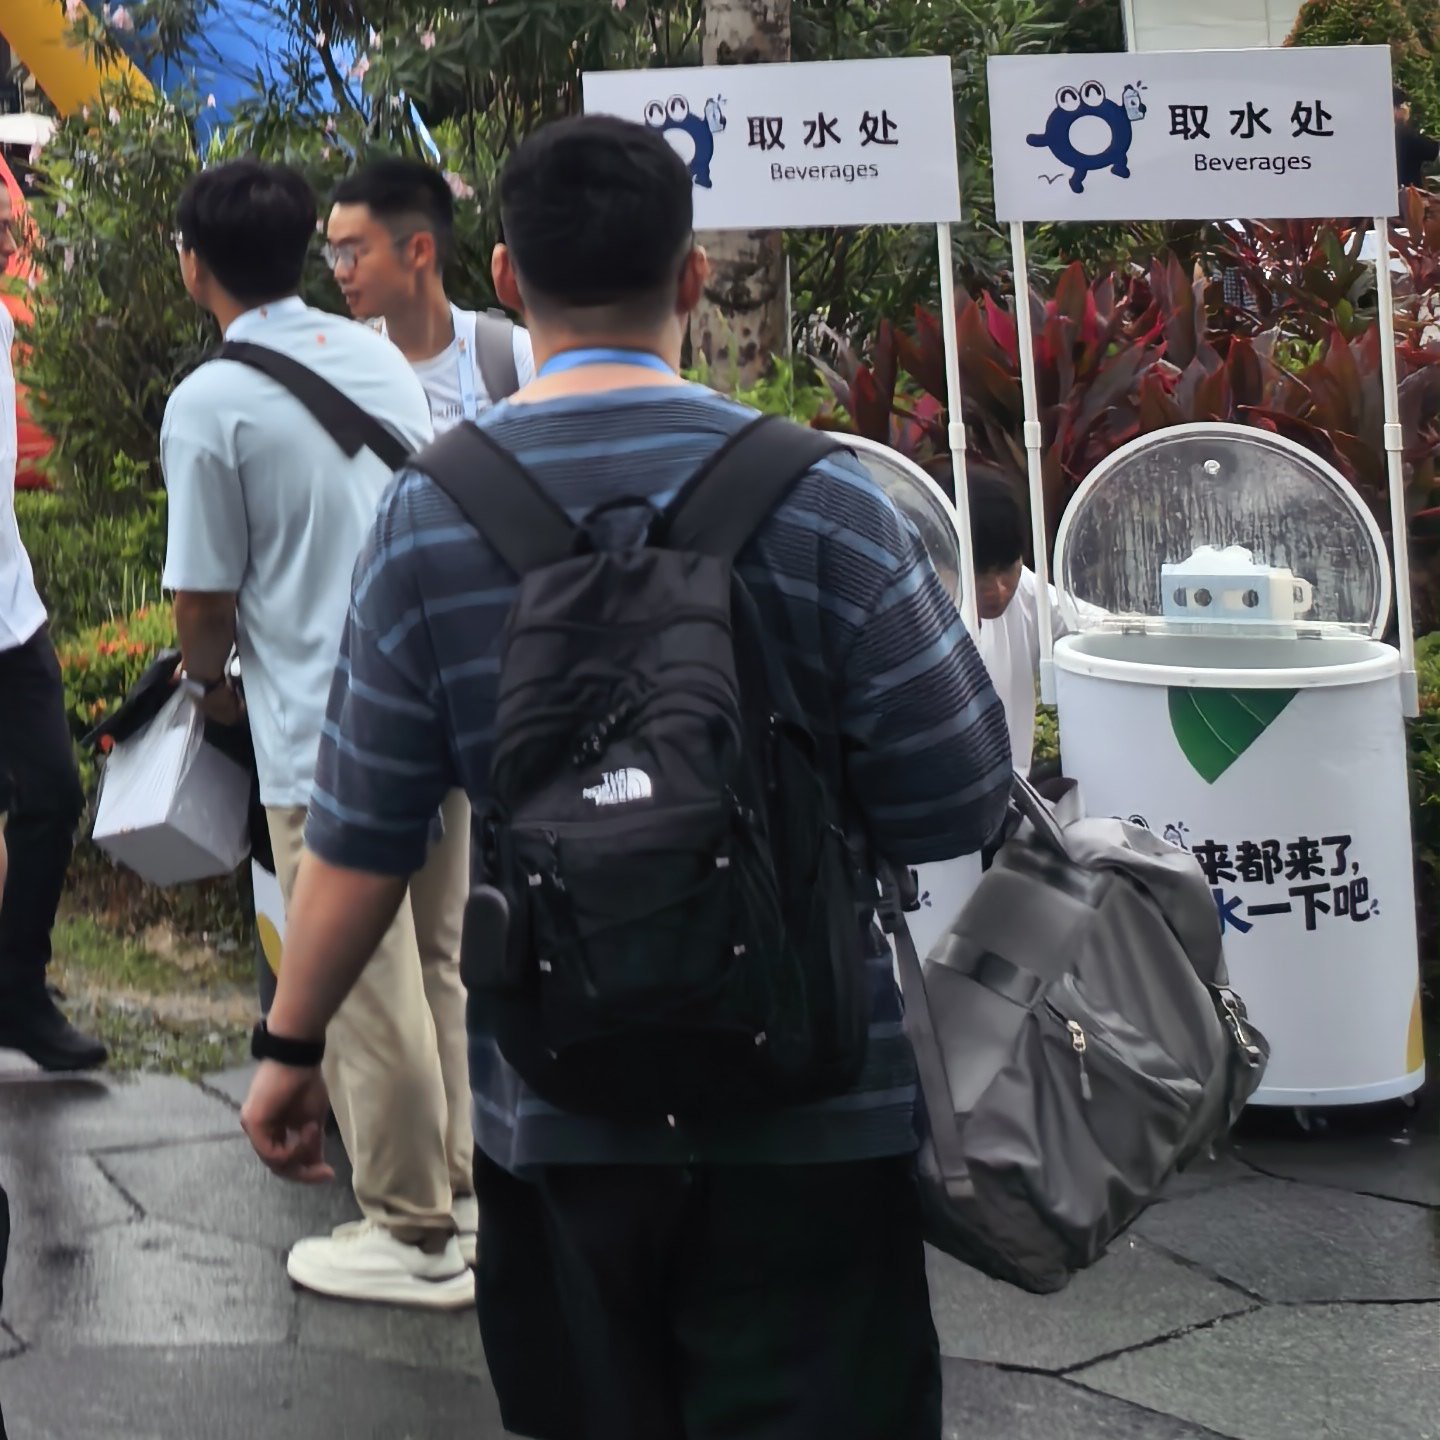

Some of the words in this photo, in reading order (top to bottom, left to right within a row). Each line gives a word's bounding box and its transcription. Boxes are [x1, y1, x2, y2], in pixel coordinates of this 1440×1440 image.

[746, 109, 900, 152] 取水处
[1168, 99, 1335, 141] 取水处
[770, 161, 880, 183] Beverages
[1194, 153, 1313, 175] Beverages
